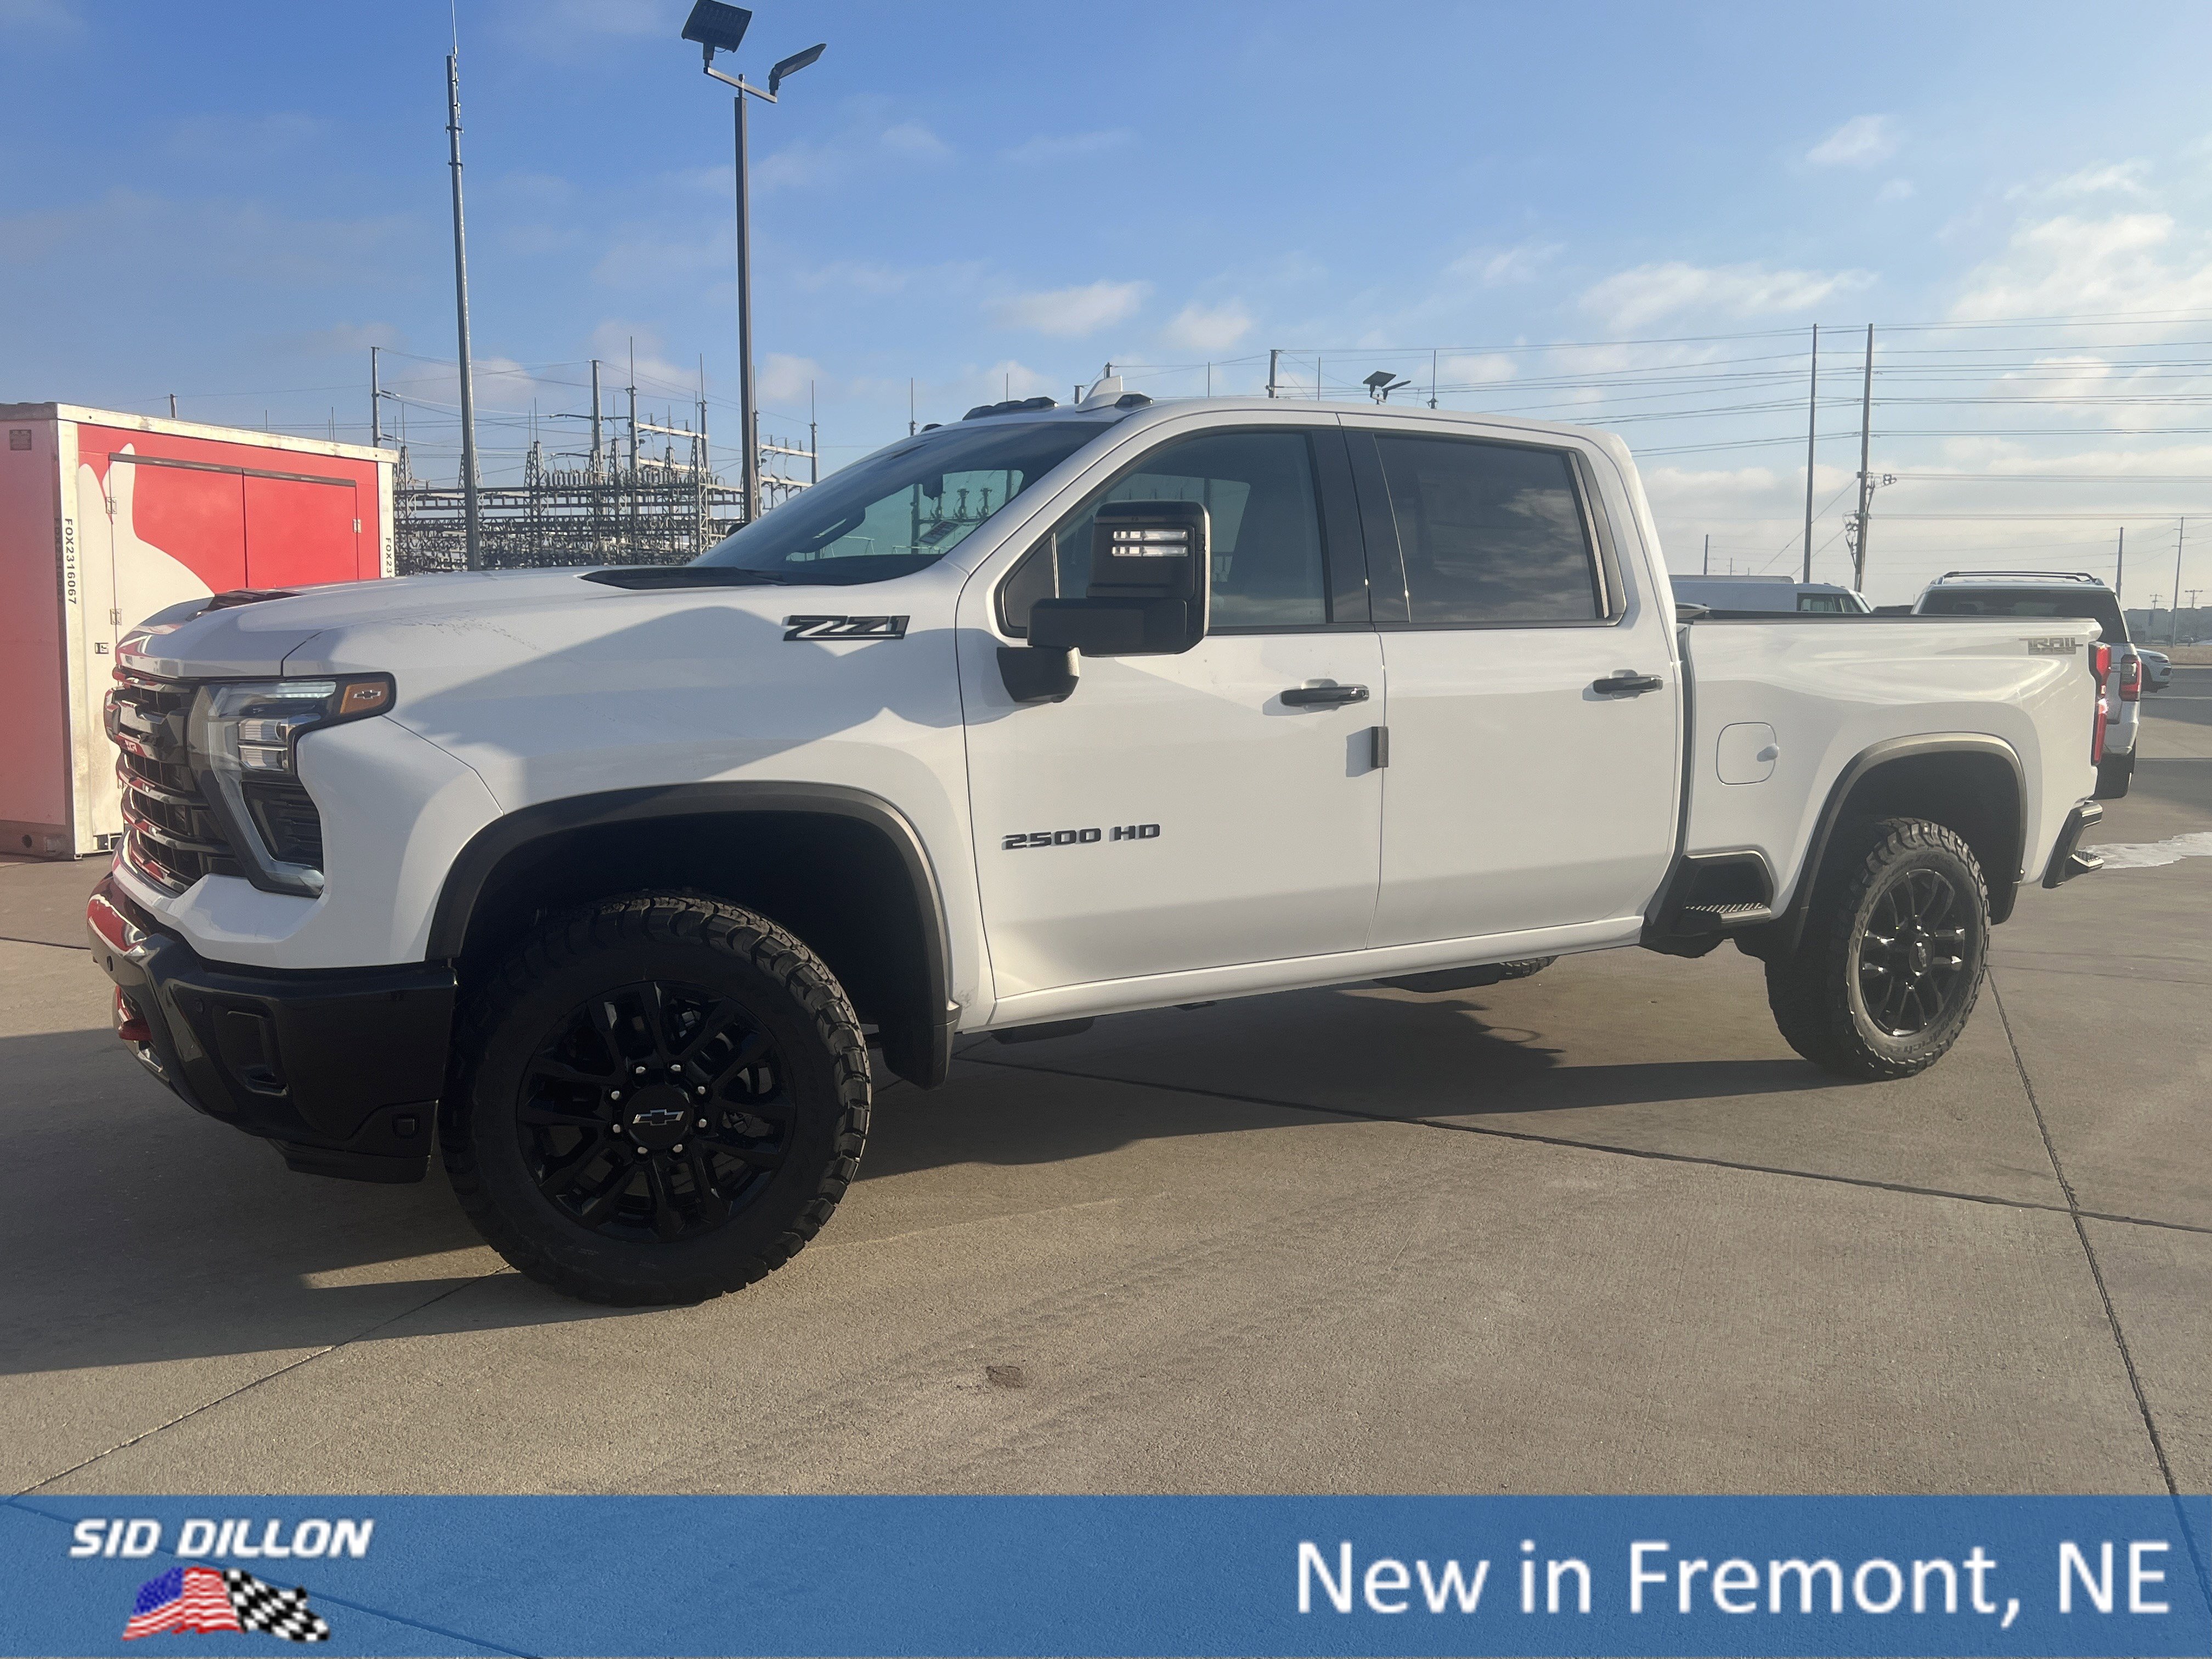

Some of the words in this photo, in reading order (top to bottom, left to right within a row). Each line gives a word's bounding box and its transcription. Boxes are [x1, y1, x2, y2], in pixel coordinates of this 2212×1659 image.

[65, 518, 77, 604] FOX2316067
[783, 615, 910, 641] Z71
[2019, 637, 2083, 648] TRAIL
[1004, 828, 1101, 850] 2500
[1111, 824, 1160, 841] HD
